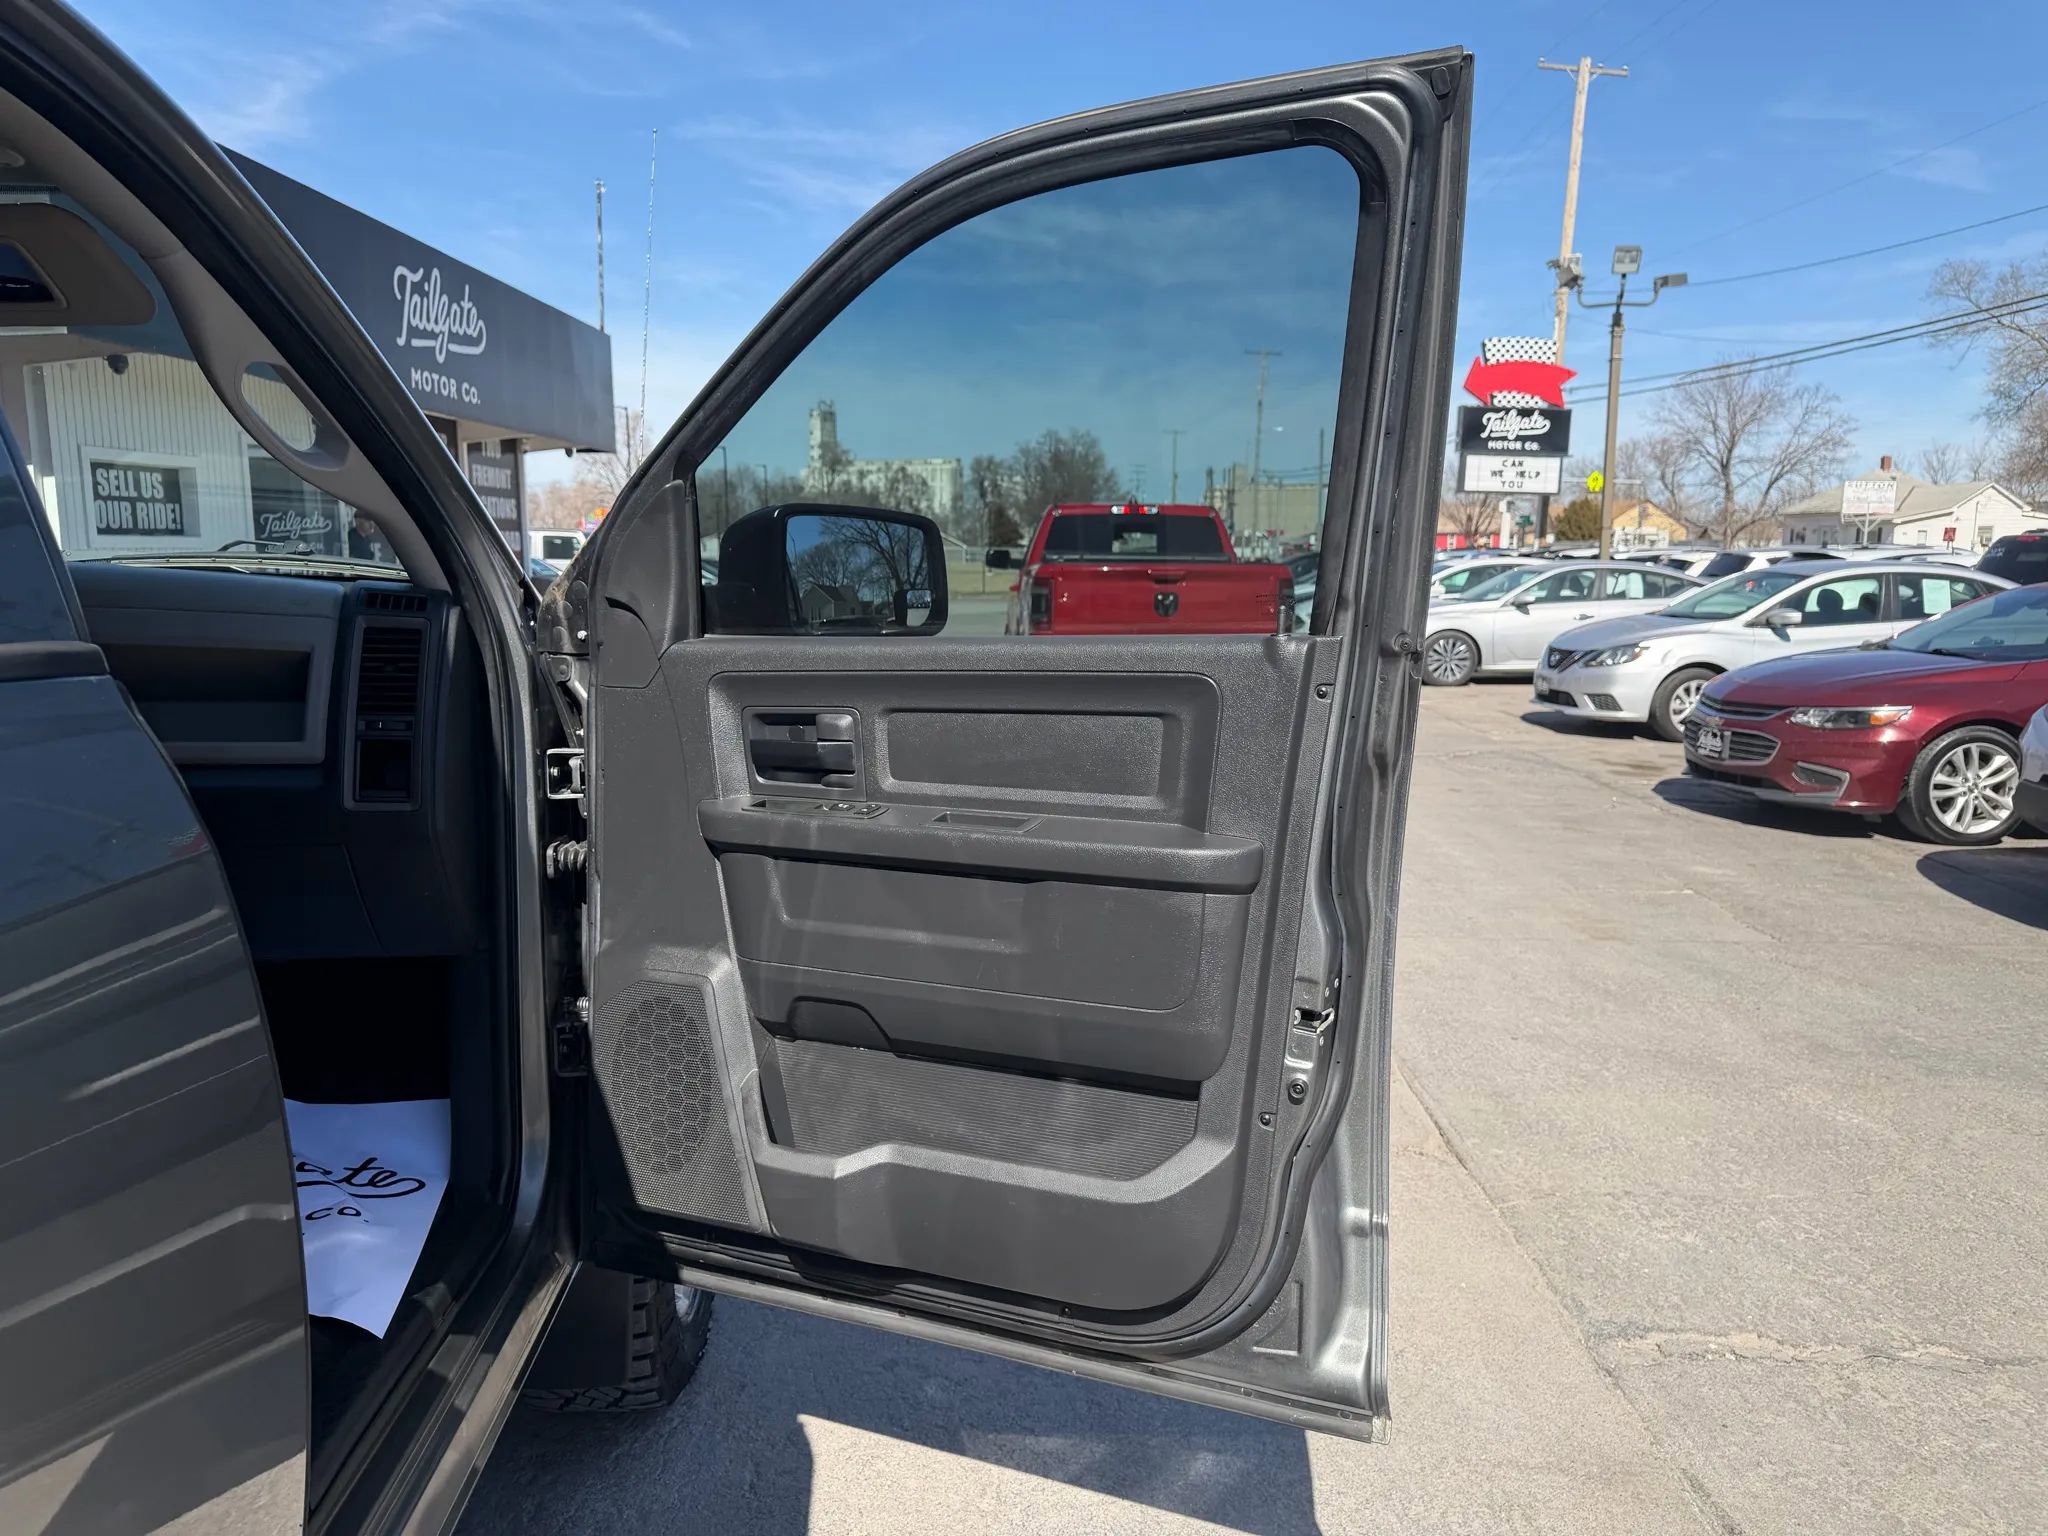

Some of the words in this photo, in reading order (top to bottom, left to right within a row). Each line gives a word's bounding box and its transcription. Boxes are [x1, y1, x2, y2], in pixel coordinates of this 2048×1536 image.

[393, 265, 487, 364] Tailgate
[411, 367, 458, 400] MOTOR
[462, 382, 481, 405] CO.
[1480, 408, 1551, 440] Tailgate
[1487, 440, 1522, 450] MOTOR
[95, 467, 138, 497] SELL
[139, 471, 164, 499] US
[1490, 470, 1504, 478] WE
[1516, 470, 1541, 478] HELP
[94, 499, 133, 529] OUR
[136, 501, 182, 530] RIDE!
[260, 510, 332, 539] Tailgate
